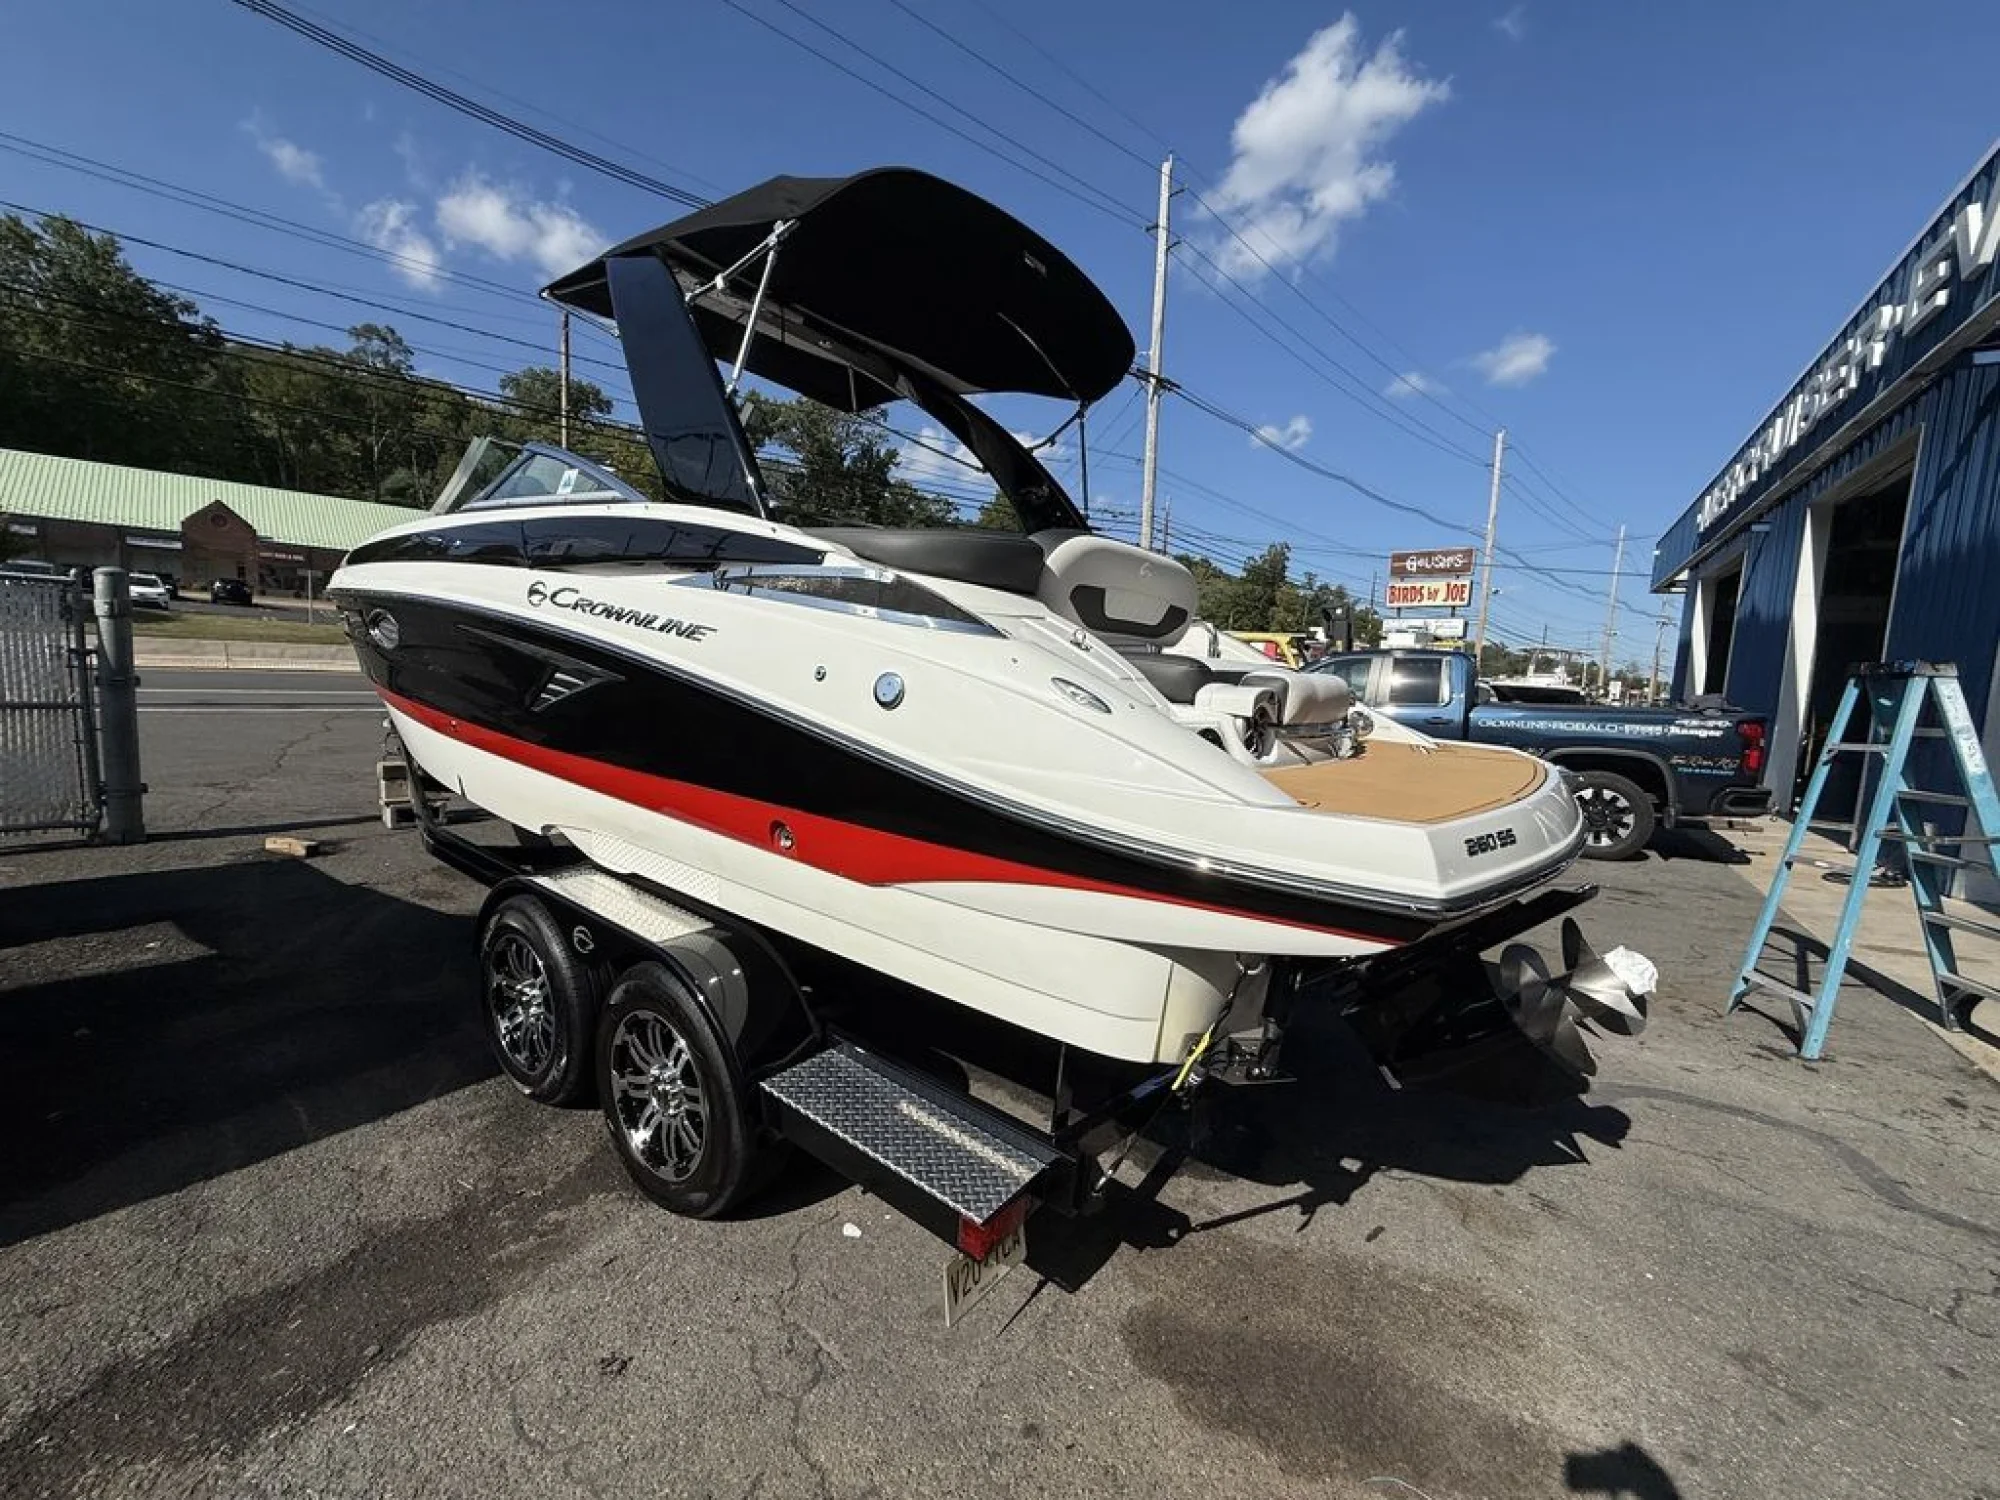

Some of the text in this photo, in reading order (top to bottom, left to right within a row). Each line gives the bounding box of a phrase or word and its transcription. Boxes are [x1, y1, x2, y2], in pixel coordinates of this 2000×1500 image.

[1388, 585, 1424, 604] BIRDS
[1442, 582, 1467, 602] JOE
[549, 587, 719, 642] CROWNLINE
